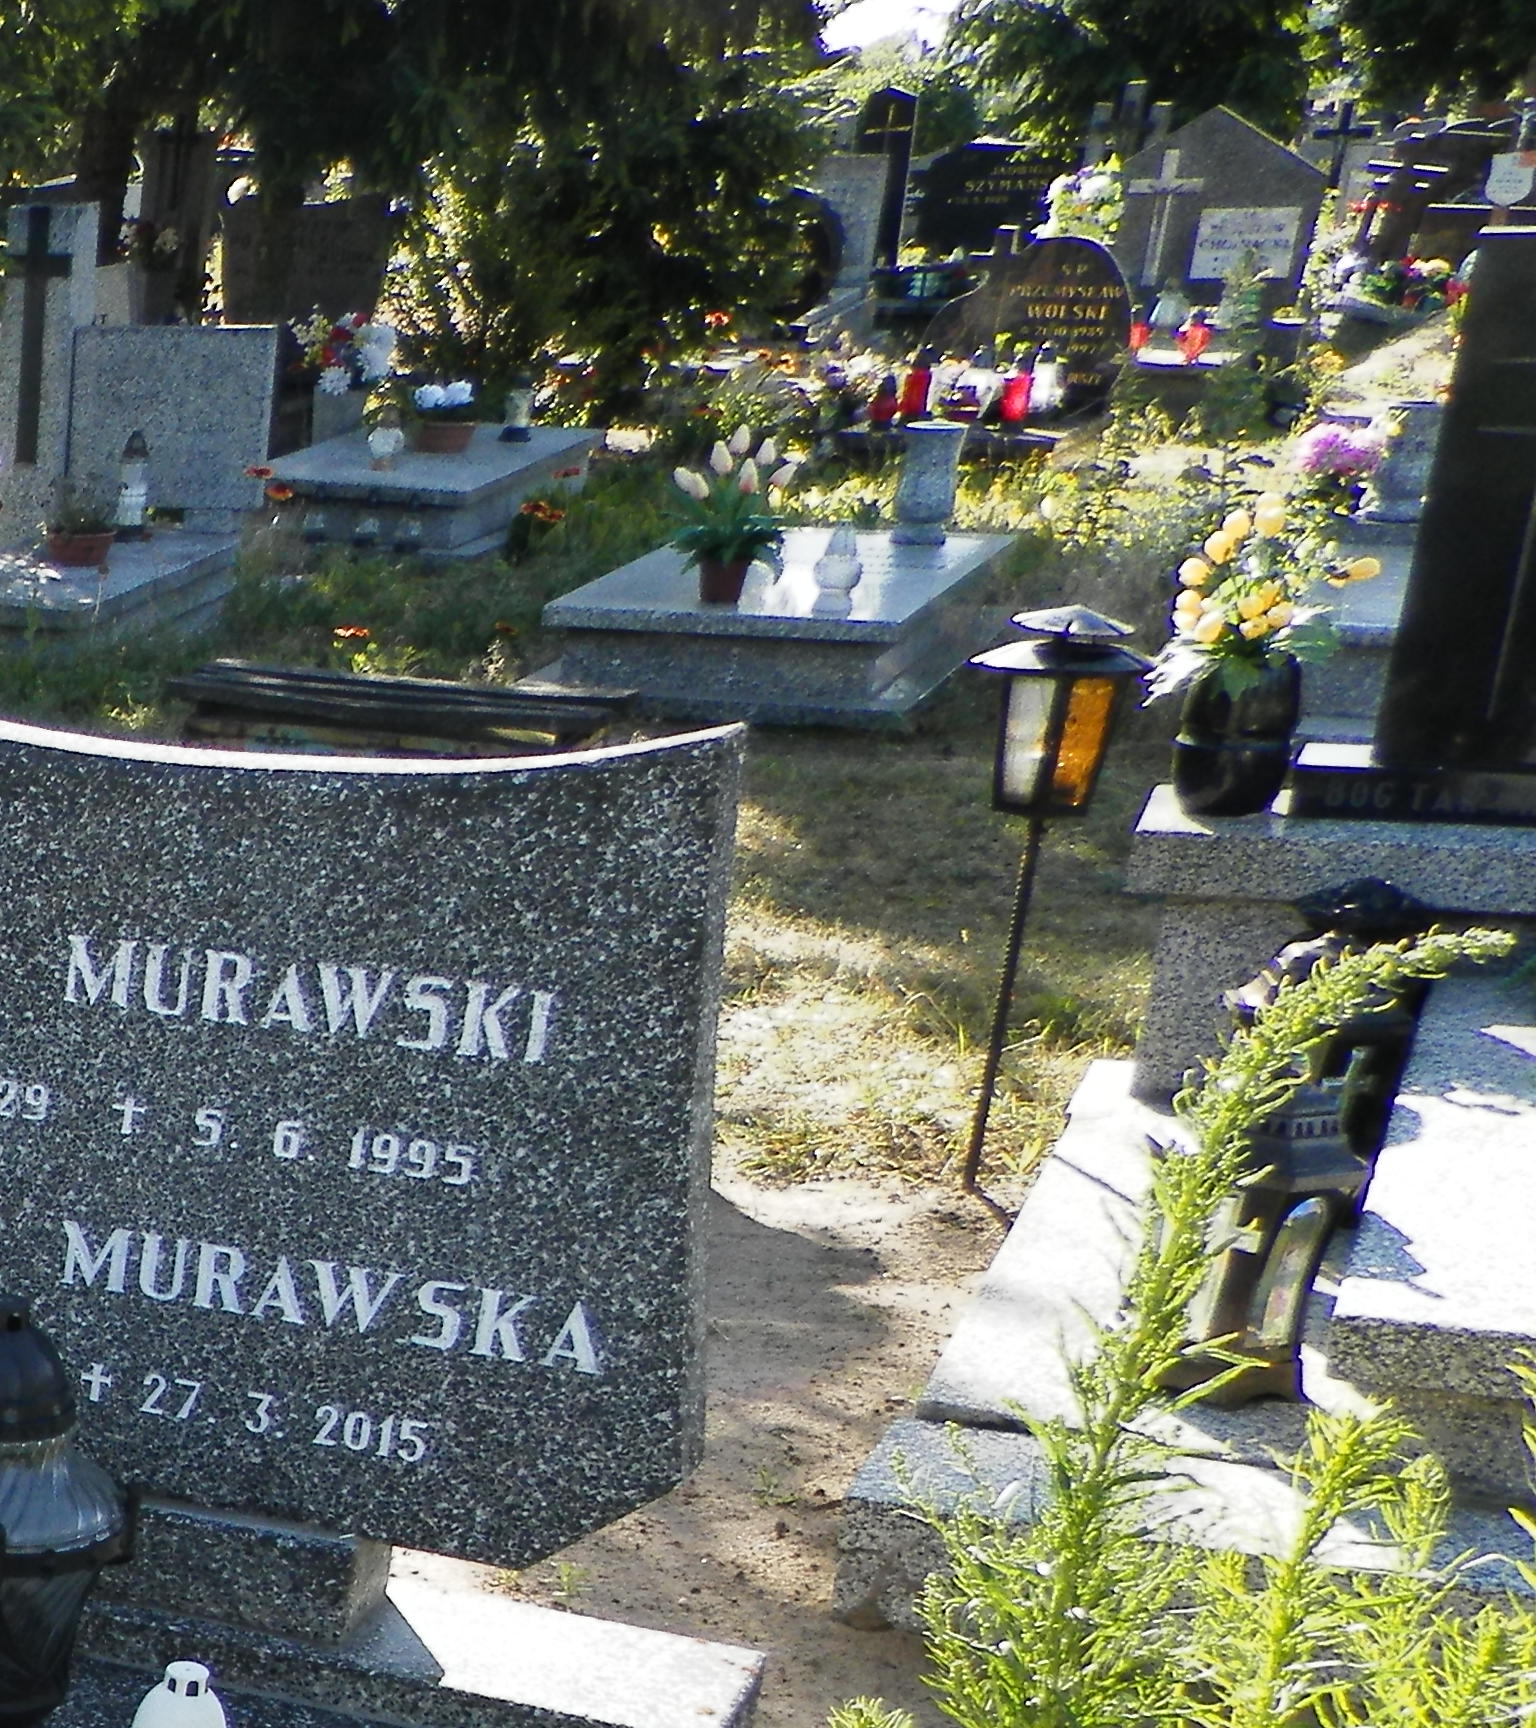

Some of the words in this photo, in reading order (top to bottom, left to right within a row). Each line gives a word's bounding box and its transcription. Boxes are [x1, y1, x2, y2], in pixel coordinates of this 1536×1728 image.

[62, 932, 559, 1066] MURAWSKI
[347, 1125, 478, 1186] 1995
[60, 1217, 606, 1376] MURAWSKA
[312, 1403, 430, 1463] 2015
